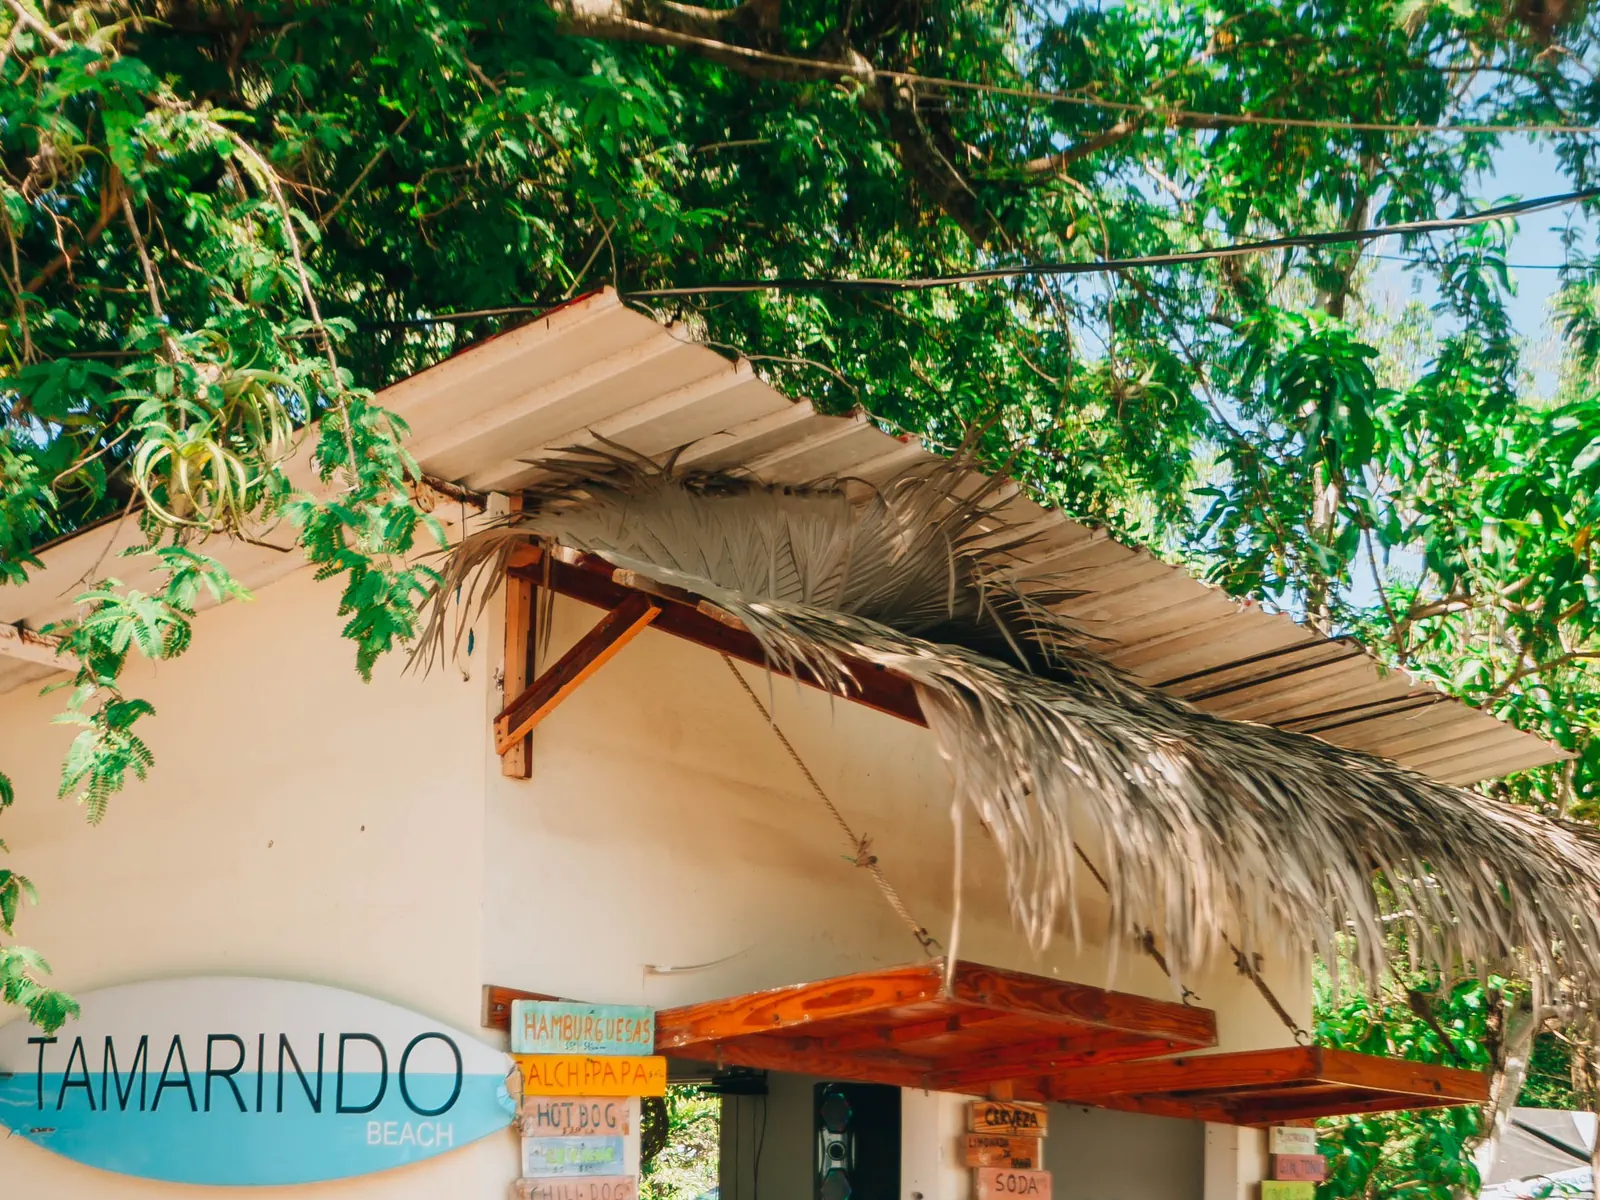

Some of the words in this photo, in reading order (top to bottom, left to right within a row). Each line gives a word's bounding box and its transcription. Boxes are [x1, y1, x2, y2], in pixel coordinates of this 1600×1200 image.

[523, 1012, 651, 1044] HAMBURGUESAS
[27, 1031, 464, 1117] TAMARINDO
[515, 1060, 648, 1088] ALCHIPAPA
[537, 1103, 574, 1127] HOT
[366, 1121, 454, 1147] BEACH
[995, 1172, 1040, 1195] SODA
